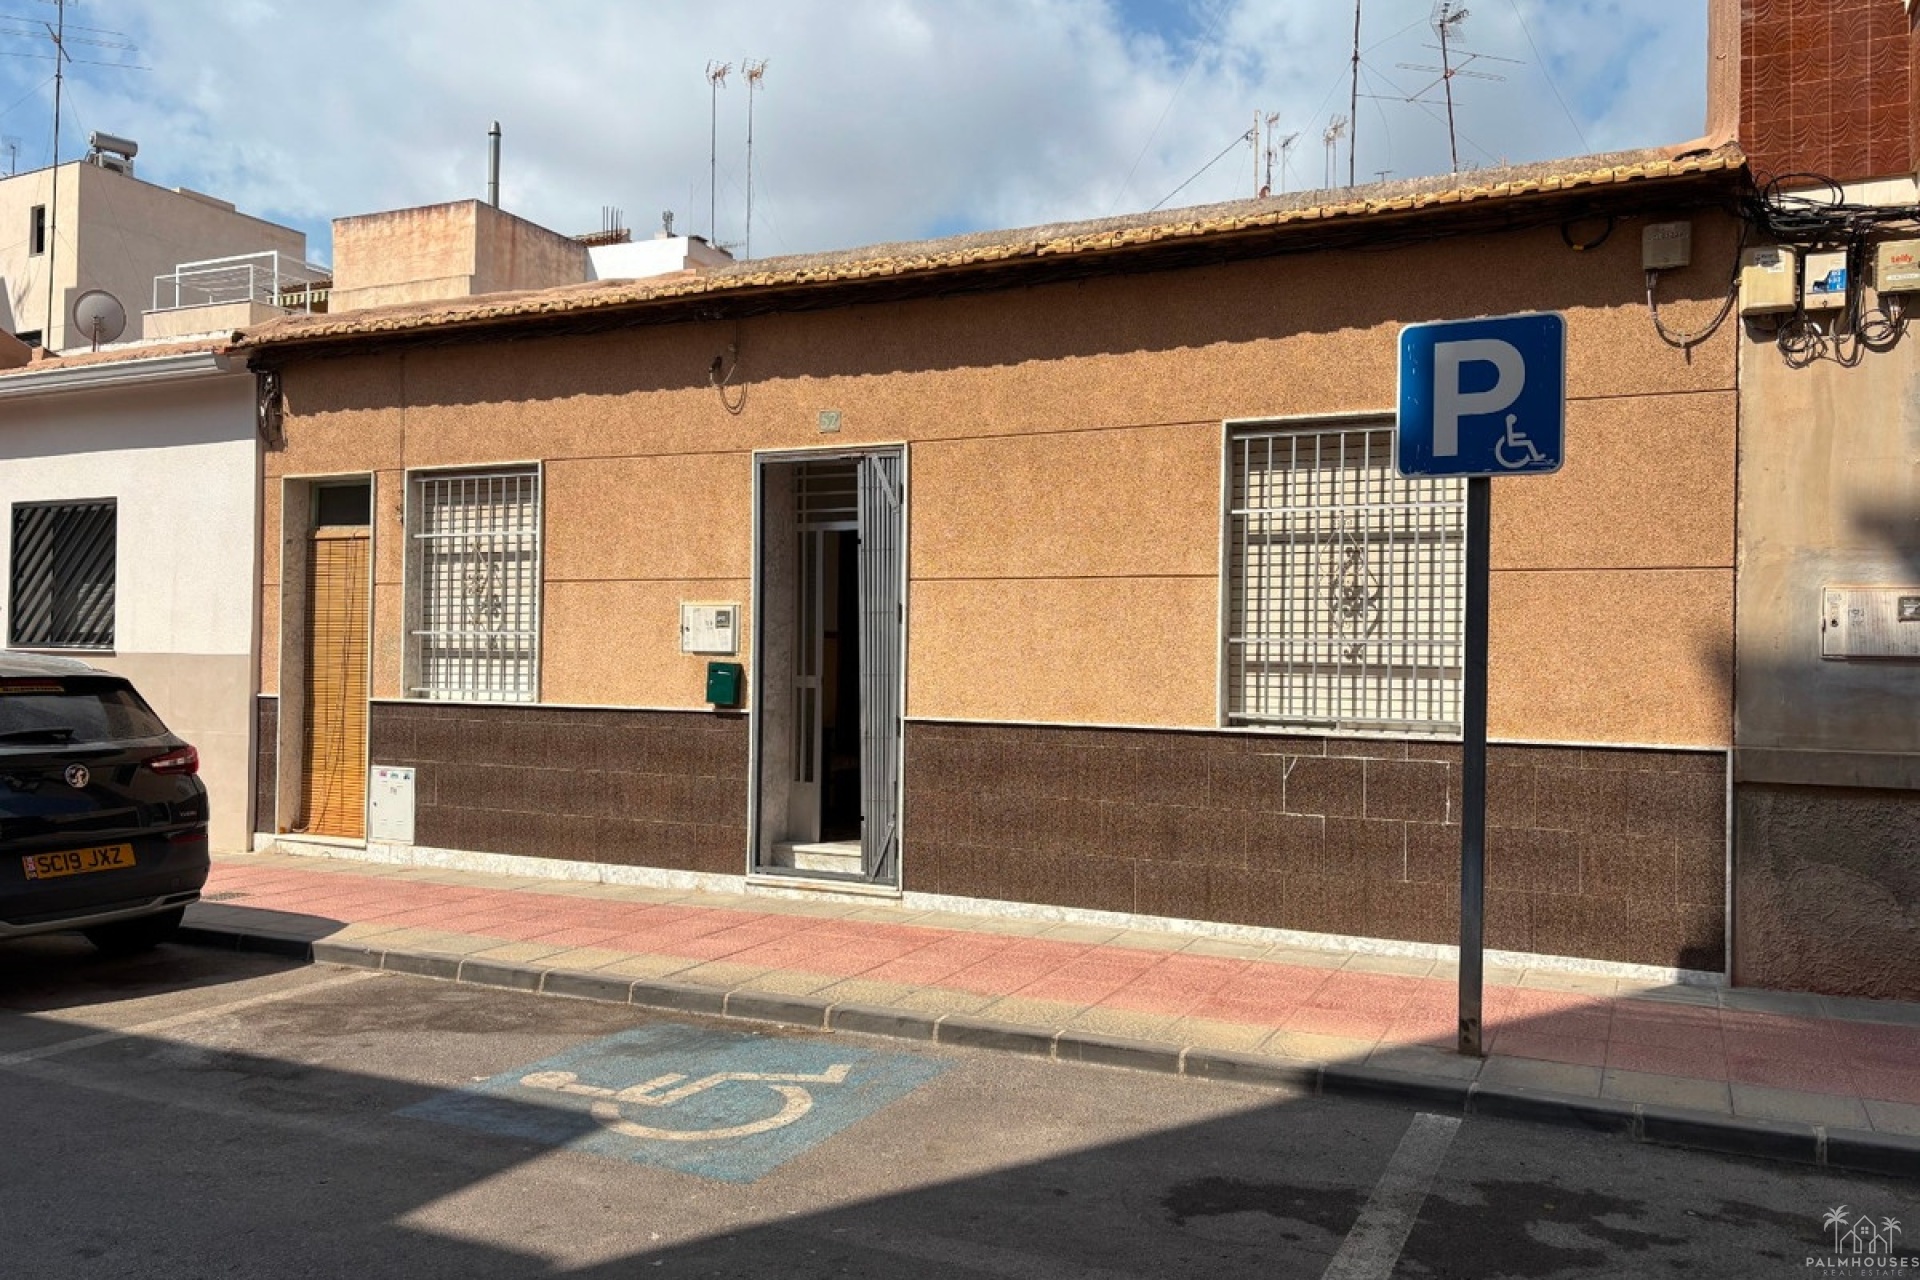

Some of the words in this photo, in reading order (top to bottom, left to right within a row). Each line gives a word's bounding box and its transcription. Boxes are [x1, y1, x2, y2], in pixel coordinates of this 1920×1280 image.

[1432, 338, 1526, 457] P
[37, 852, 82, 874] SC19
[88, 847, 124, 867] JXZ
